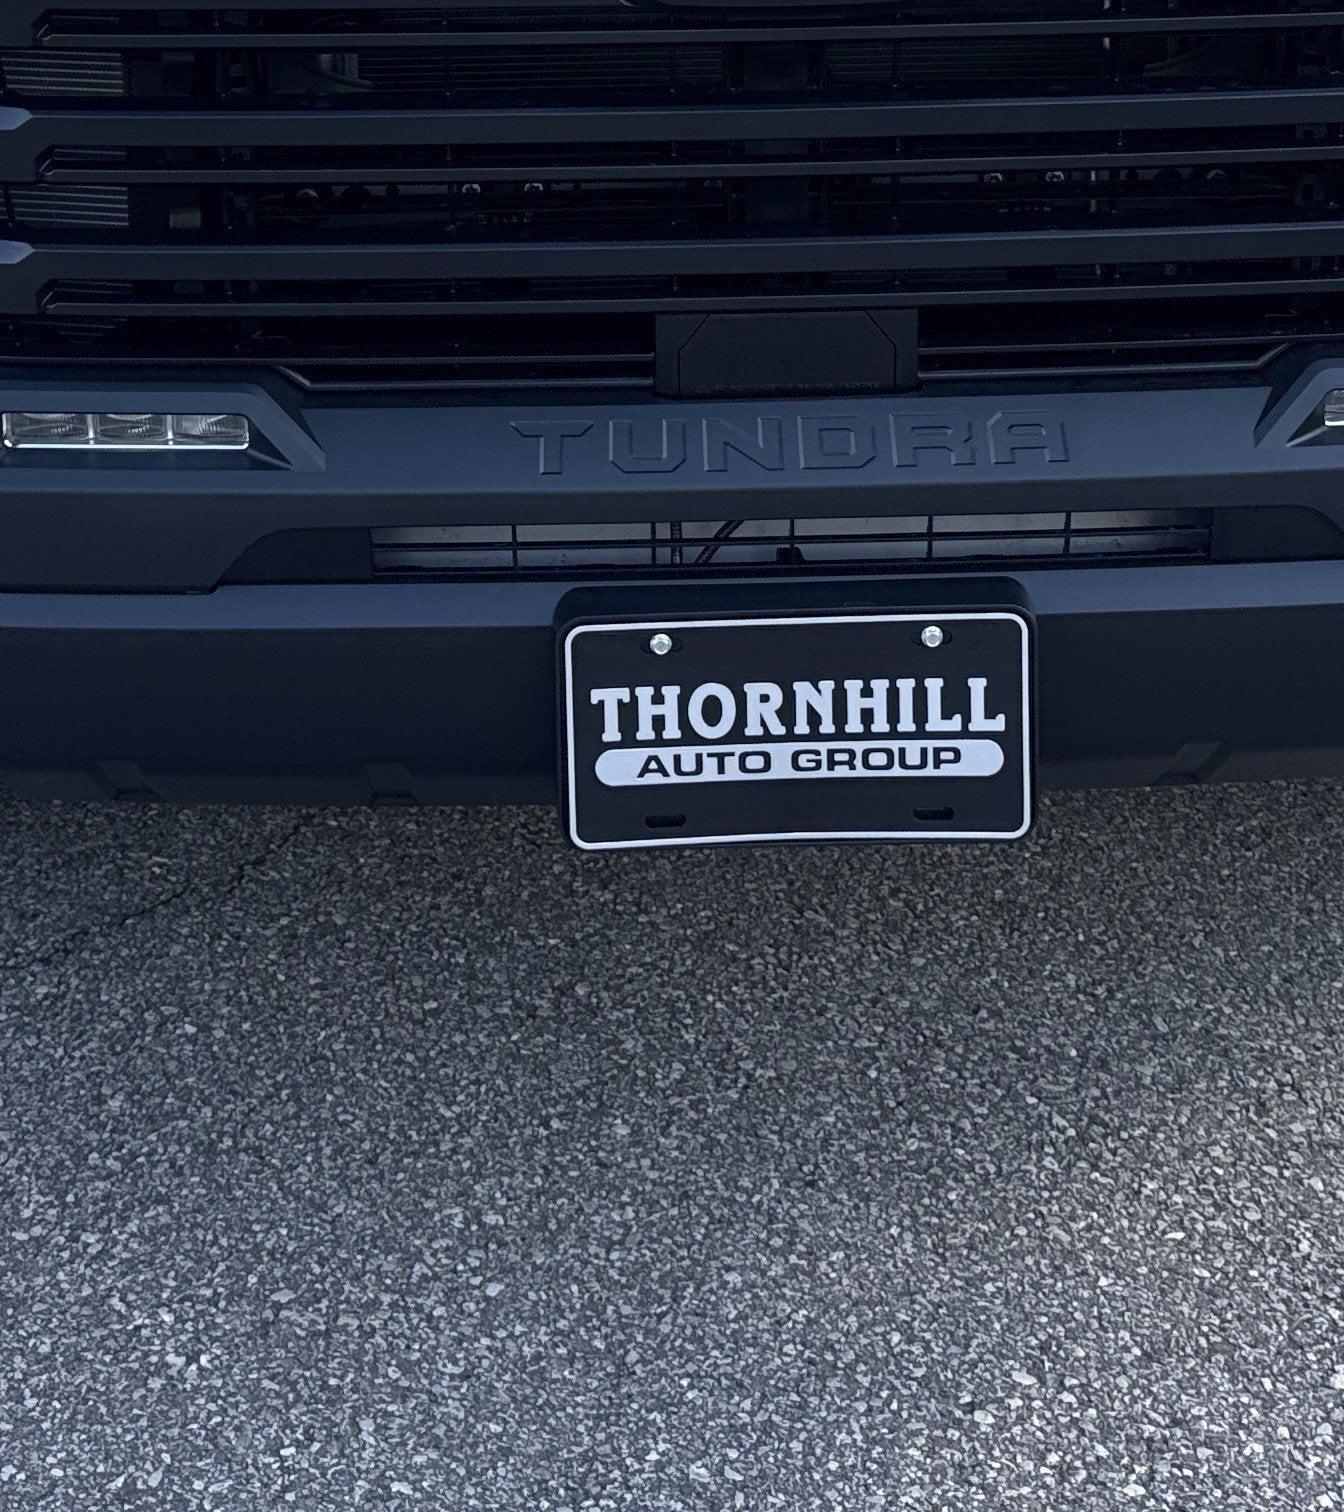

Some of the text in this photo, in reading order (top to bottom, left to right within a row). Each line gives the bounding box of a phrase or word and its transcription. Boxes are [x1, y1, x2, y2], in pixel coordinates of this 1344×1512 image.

[510, 410, 1070, 475] TUNDRA
[590, 677, 1006, 742] THORNHILL
[636, 746, 962, 778] AUTO GROUP
